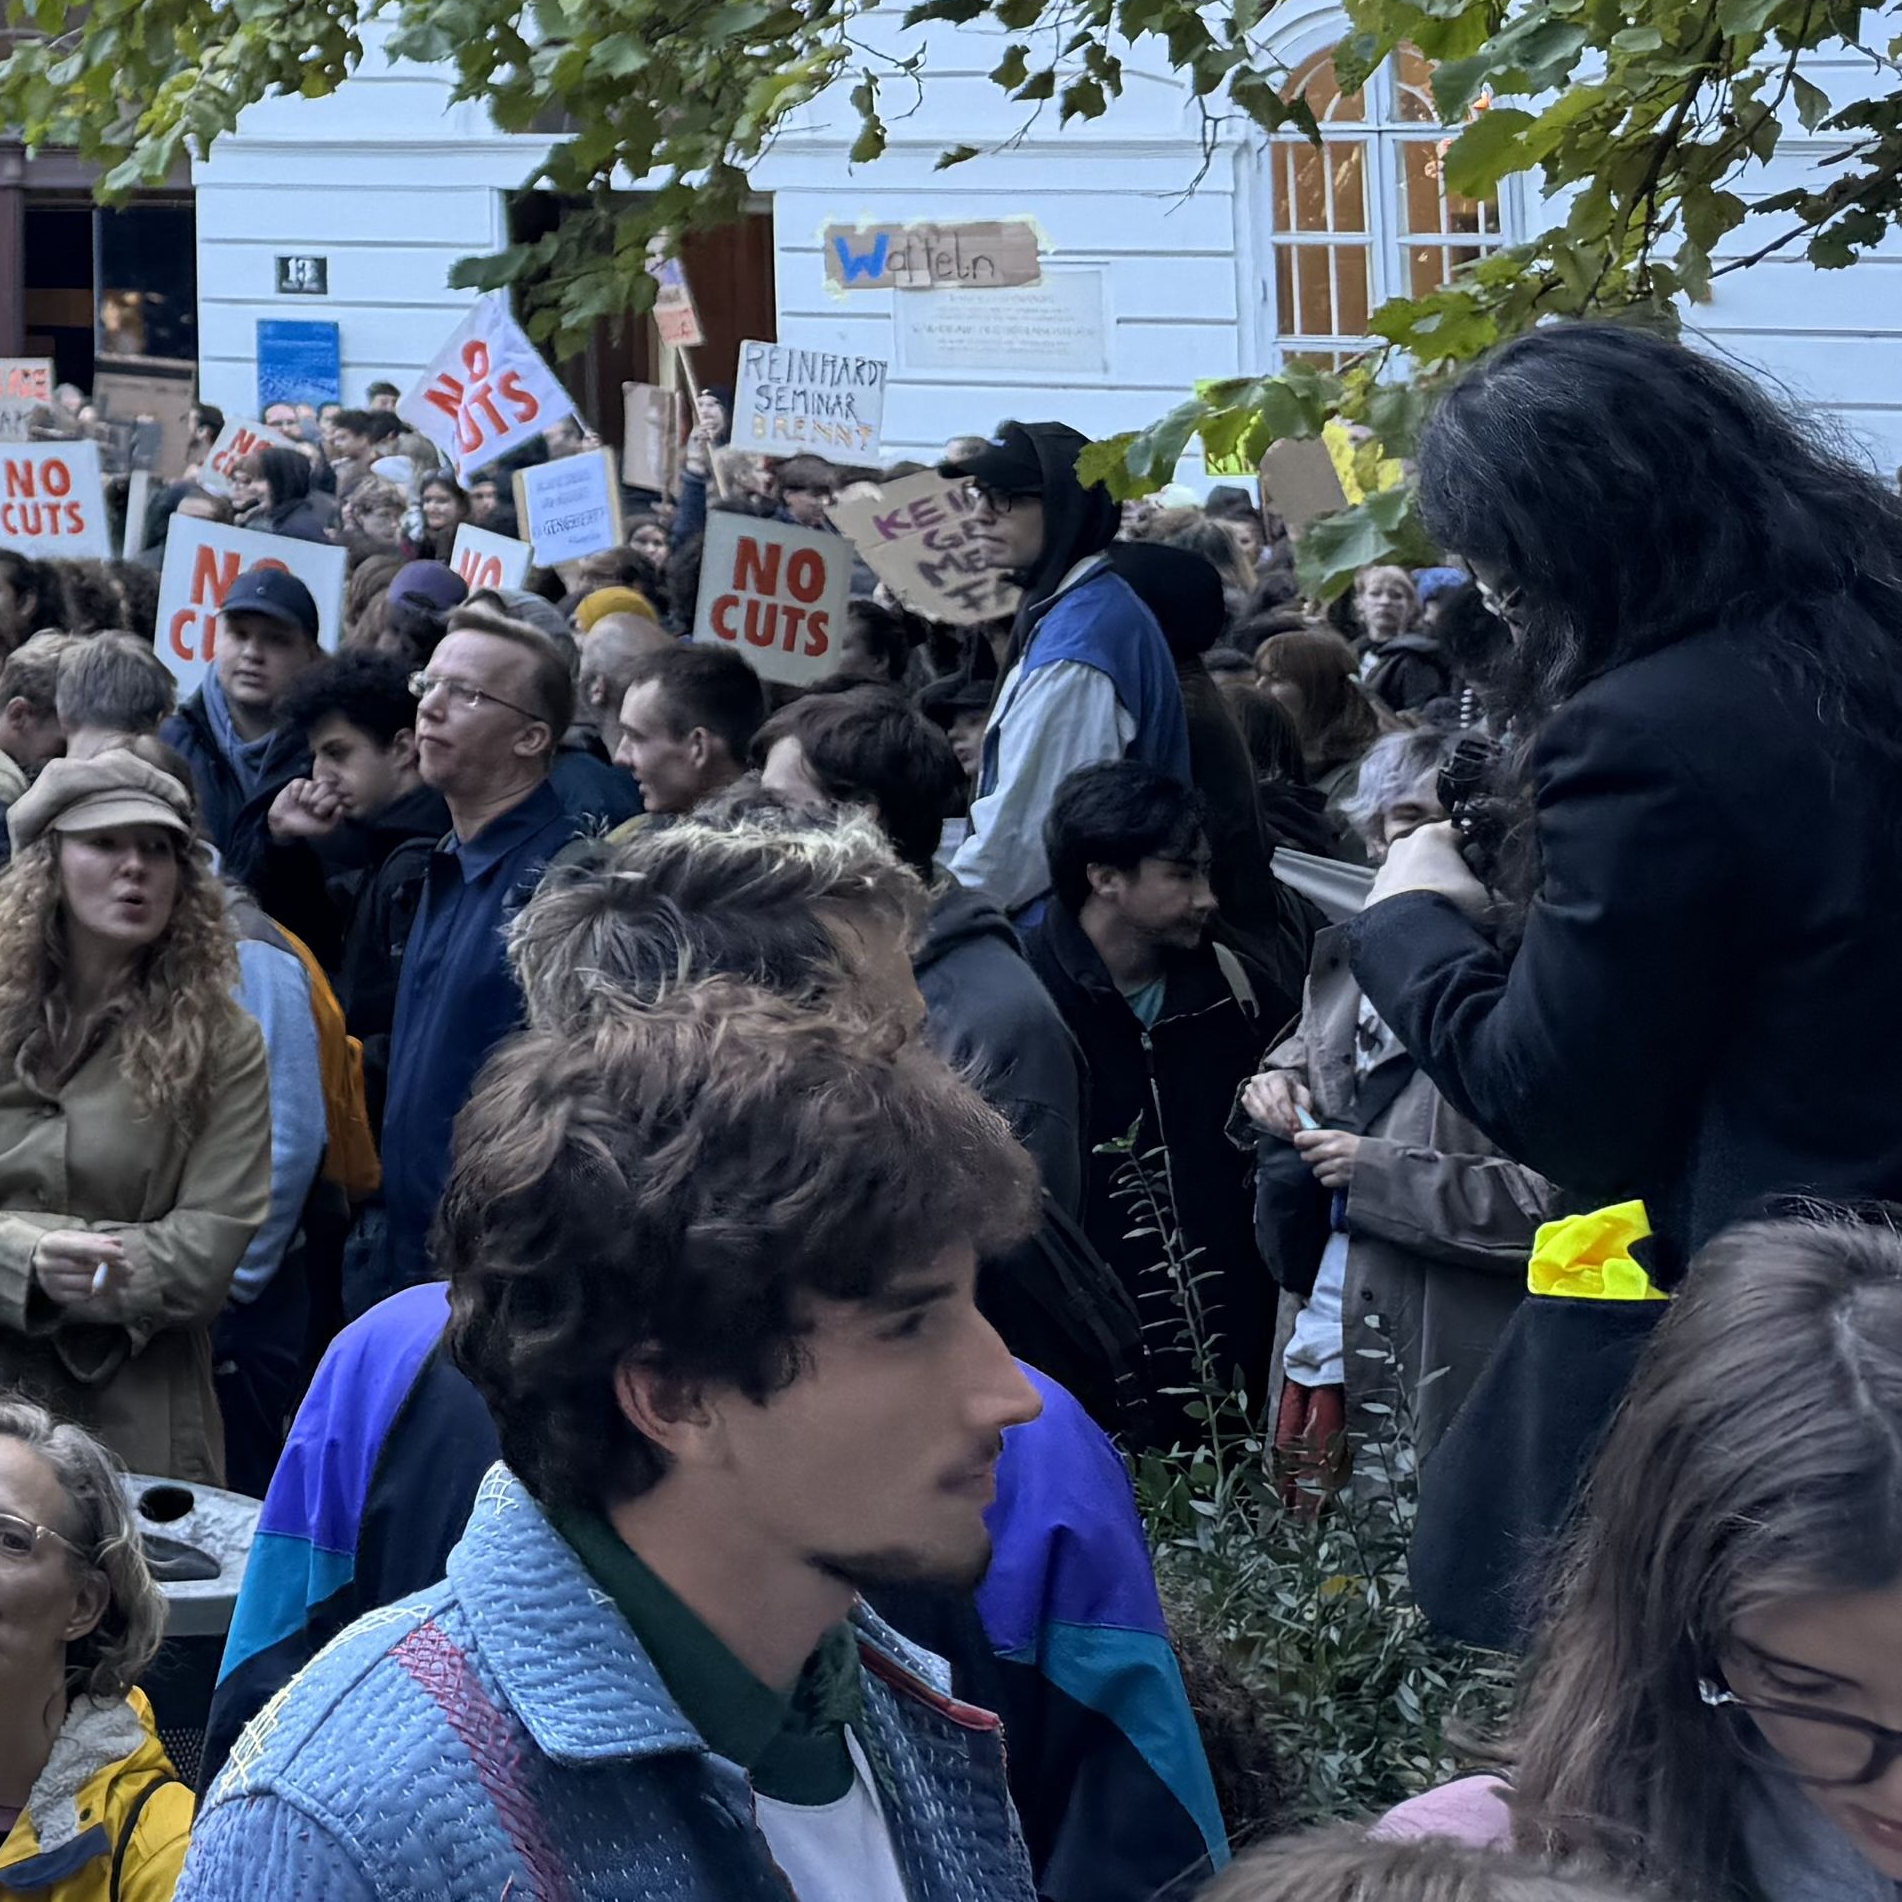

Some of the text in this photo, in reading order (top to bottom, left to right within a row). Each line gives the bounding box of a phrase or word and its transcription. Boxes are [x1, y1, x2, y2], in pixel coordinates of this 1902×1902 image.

[834, 232, 995, 284] Waffeln
[455, 370, 540, 455] UTS
[755, 384, 859, 419] SEMINAR
[4, 459, 71, 498] NO
[0, 501, 85, 536] CUTS
[733, 535, 826, 604] NO
[711, 594, 830, 657] CUTS
